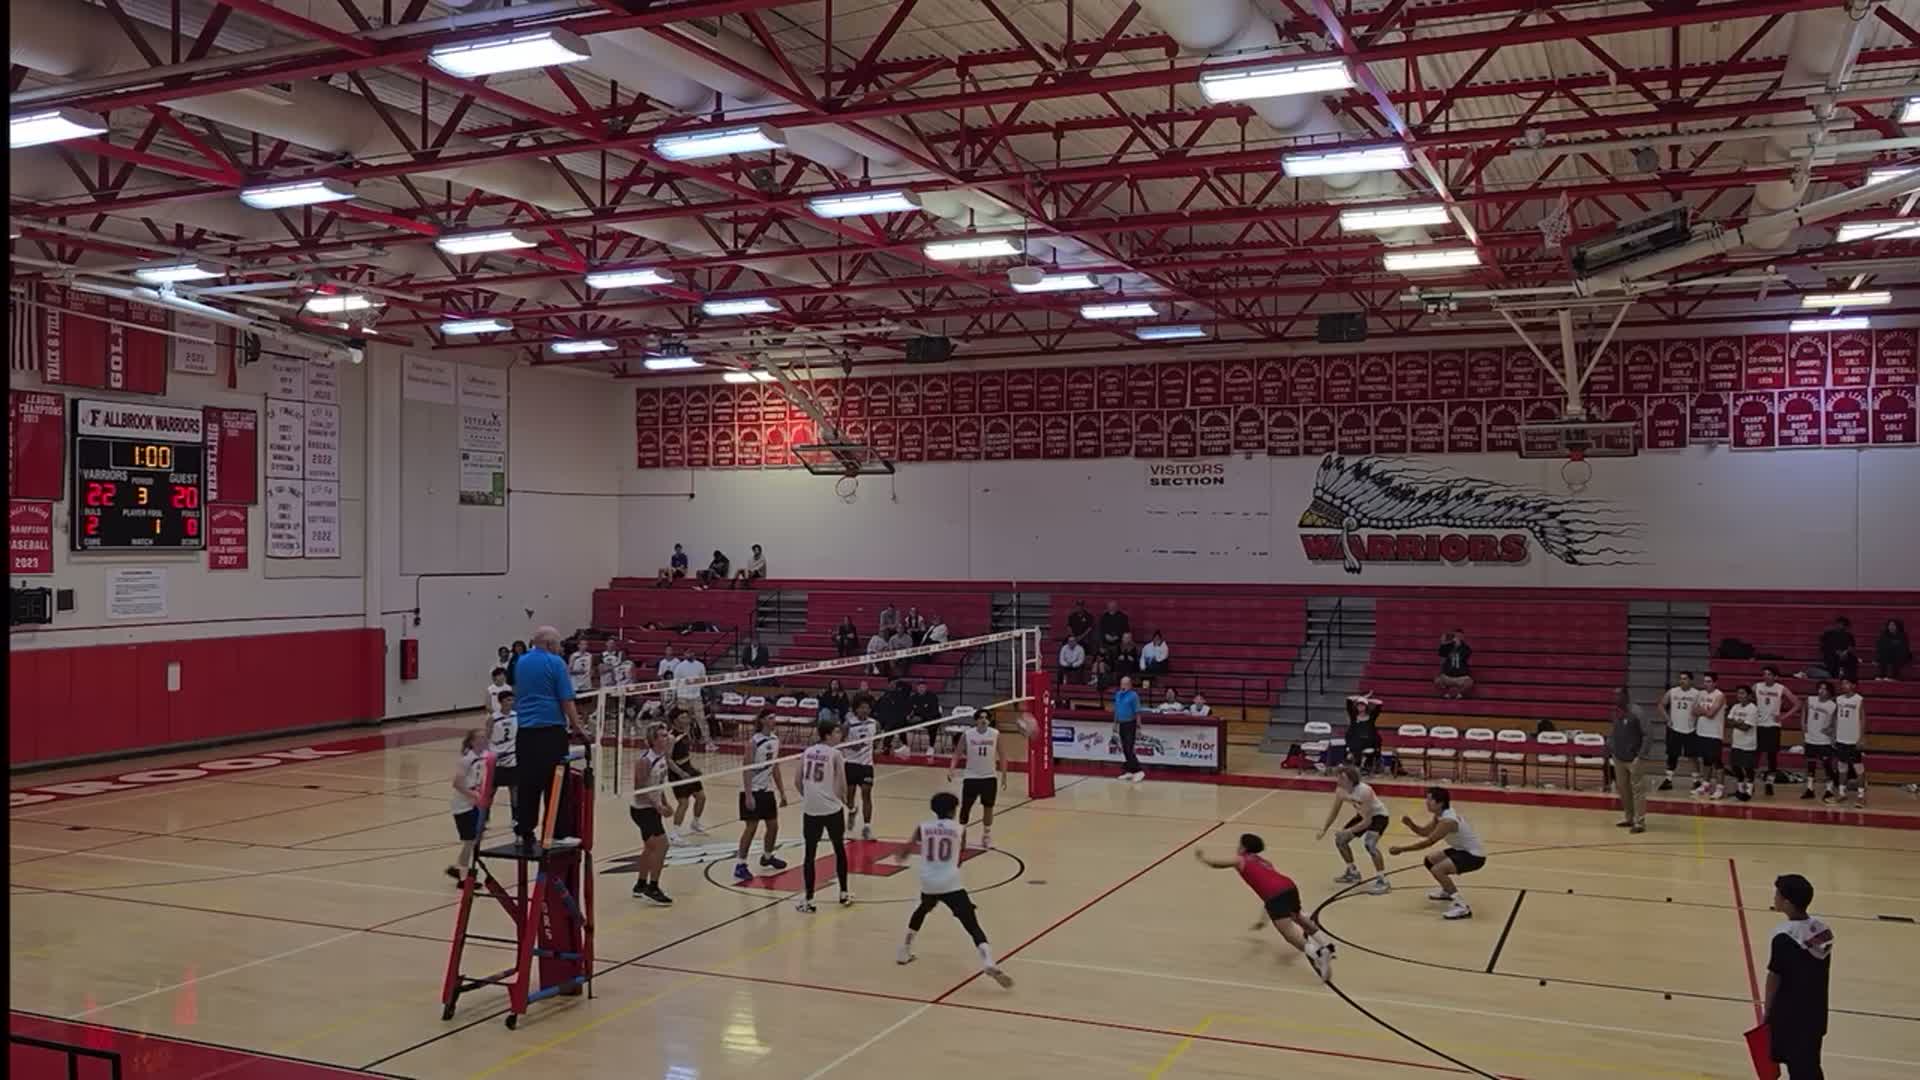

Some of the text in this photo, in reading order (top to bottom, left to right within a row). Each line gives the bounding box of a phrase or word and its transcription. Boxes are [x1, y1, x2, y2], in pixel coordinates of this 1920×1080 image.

[19, 403, 63, 416] CHAMPIONS
[155, 415, 200, 434] WARRIORS
[135, 445, 170, 468] 1:00
[207, 423, 219, 501] WRESTLING
[1150, 463, 1225, 475] VISITORS
[169, 473, 198, 484] GUEST
[1150, 476, 1225, 486] SECTION
[87, 483, 116, 506] 22
[138, 487, 148, 505] 3
[172, 486, 198, 508] 20
[87, 516, 99, 535] 2
[156, 518, 161, 534] 1
[9, 539, 49, 550] ASEBALL
[1300, 532, 1530, 565] WARRIORS
[15, 557, 39, 568] 2023
[978, 746, 988, 757] 11
[1179, 739, 1215, 752] Major
[804, 760, 825, 783] 15
[926, 837, 952, 862] 10
